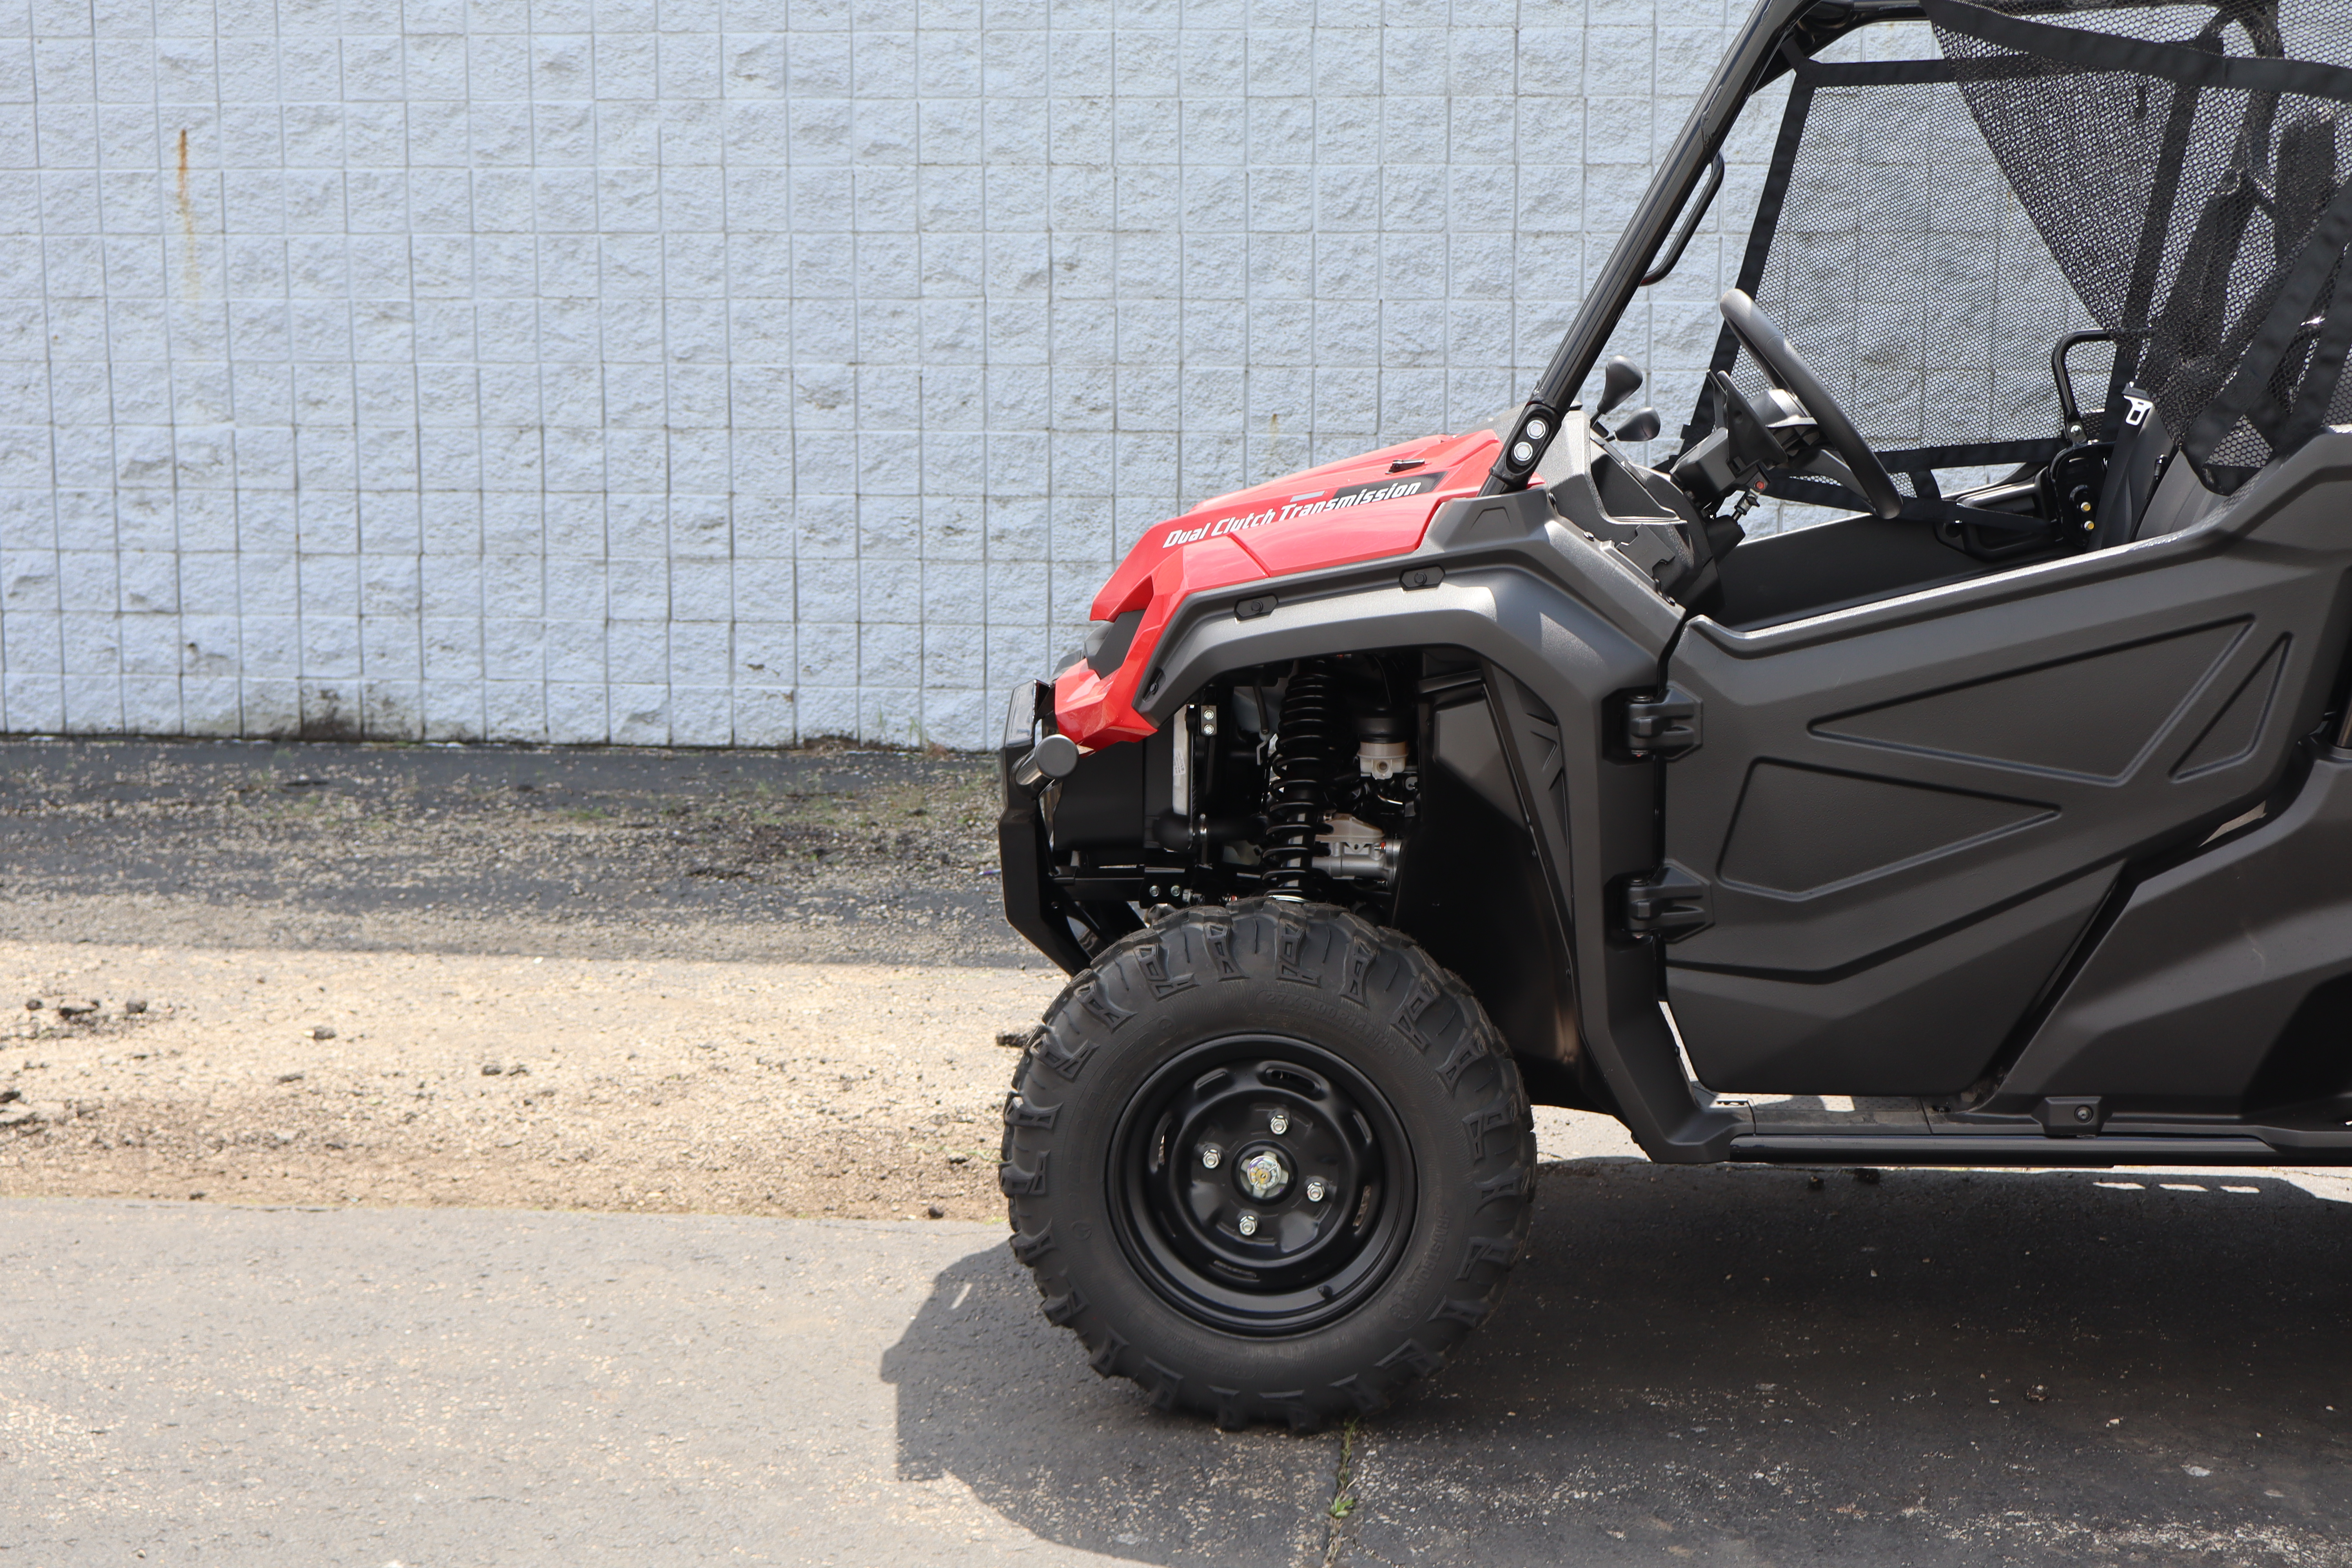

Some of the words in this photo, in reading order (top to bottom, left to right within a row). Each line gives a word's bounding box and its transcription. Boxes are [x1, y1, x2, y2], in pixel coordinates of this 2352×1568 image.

[1163, 523, 1211, 548] Dual
[1211, 510, 1276, 536] Clutch
[1279, 481, 1421, 521] Transmission
